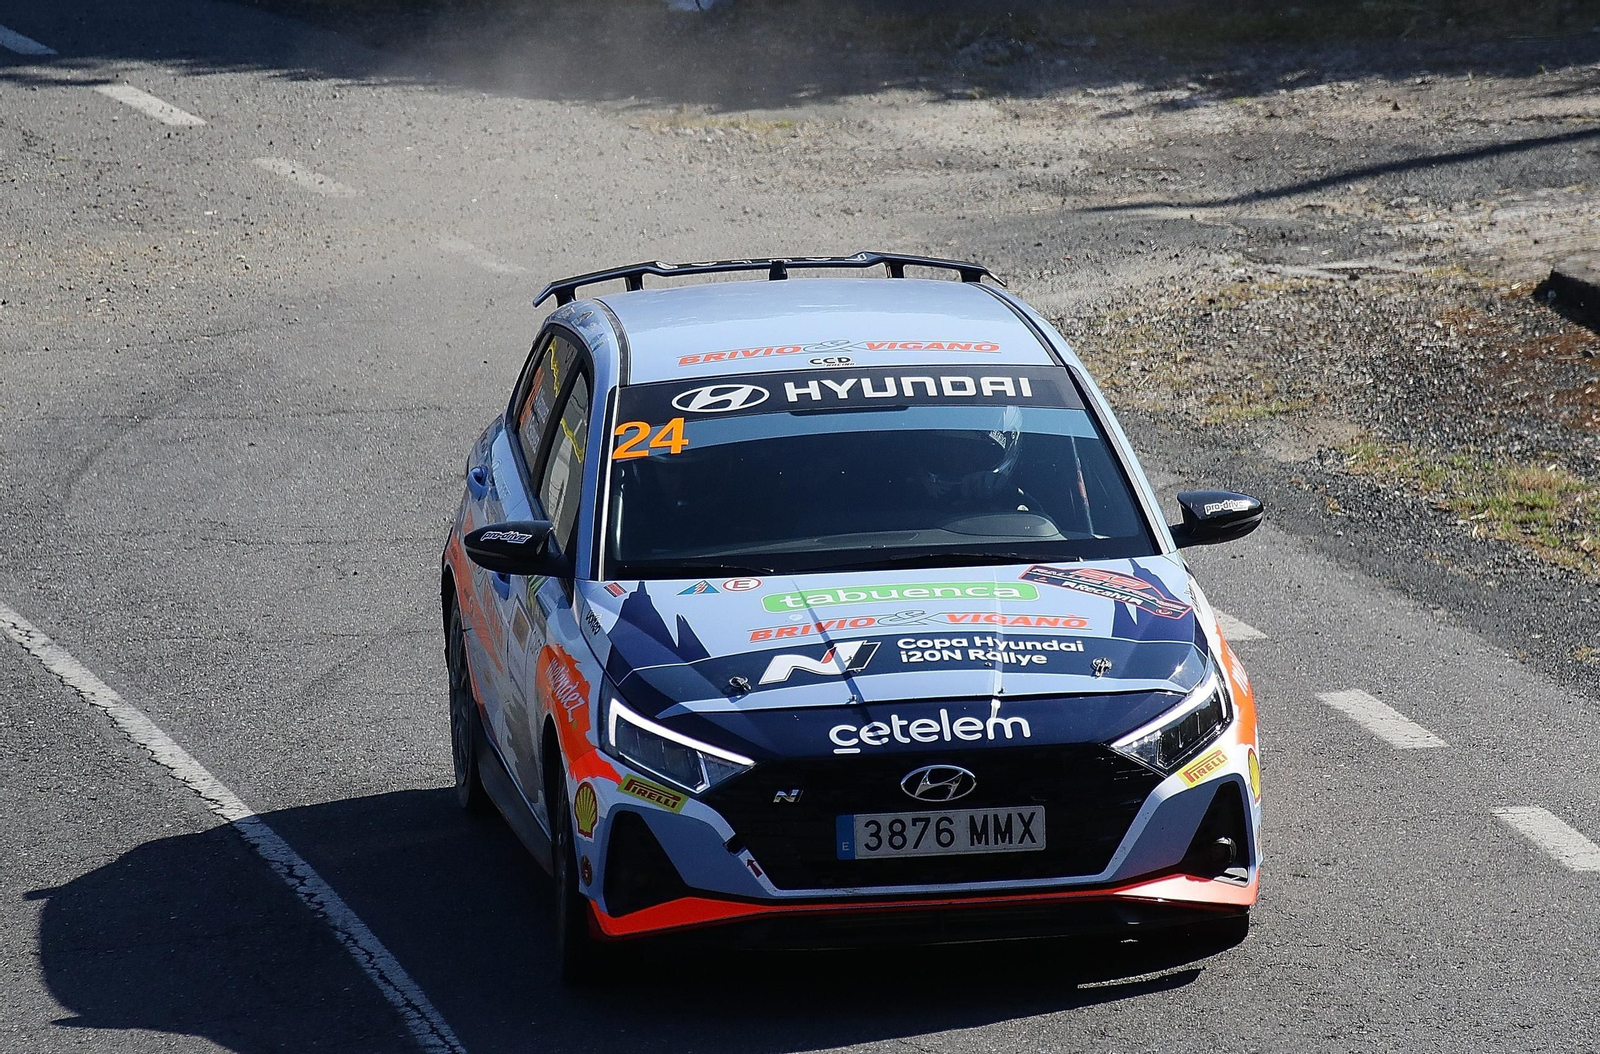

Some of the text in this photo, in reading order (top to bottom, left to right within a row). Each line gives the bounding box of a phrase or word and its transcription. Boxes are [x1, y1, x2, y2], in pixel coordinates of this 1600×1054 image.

[678, 345, 801, 367] BRIVIO
[809, 356, 852, 365] CCD
[784, 377, 1033, 402] HYUNDAI
[612, 417, 689, 460] 24
[779, 582, 1023, 608] tabuenca
[749, 617, 876, 642] BRIVIO
[897, 636, 1084, 654] Copa Hyundai
[900, 649, 1048, 667] i20N Rallye
[829, 708, 1031, 748] cetelem
[1183, 750, 1228, 783] PIRELLI
[623, 778, 682, 810] PIRELLI
[864, 816, 956, 852] 3876
[969, 811, 1038, 847] MMX
